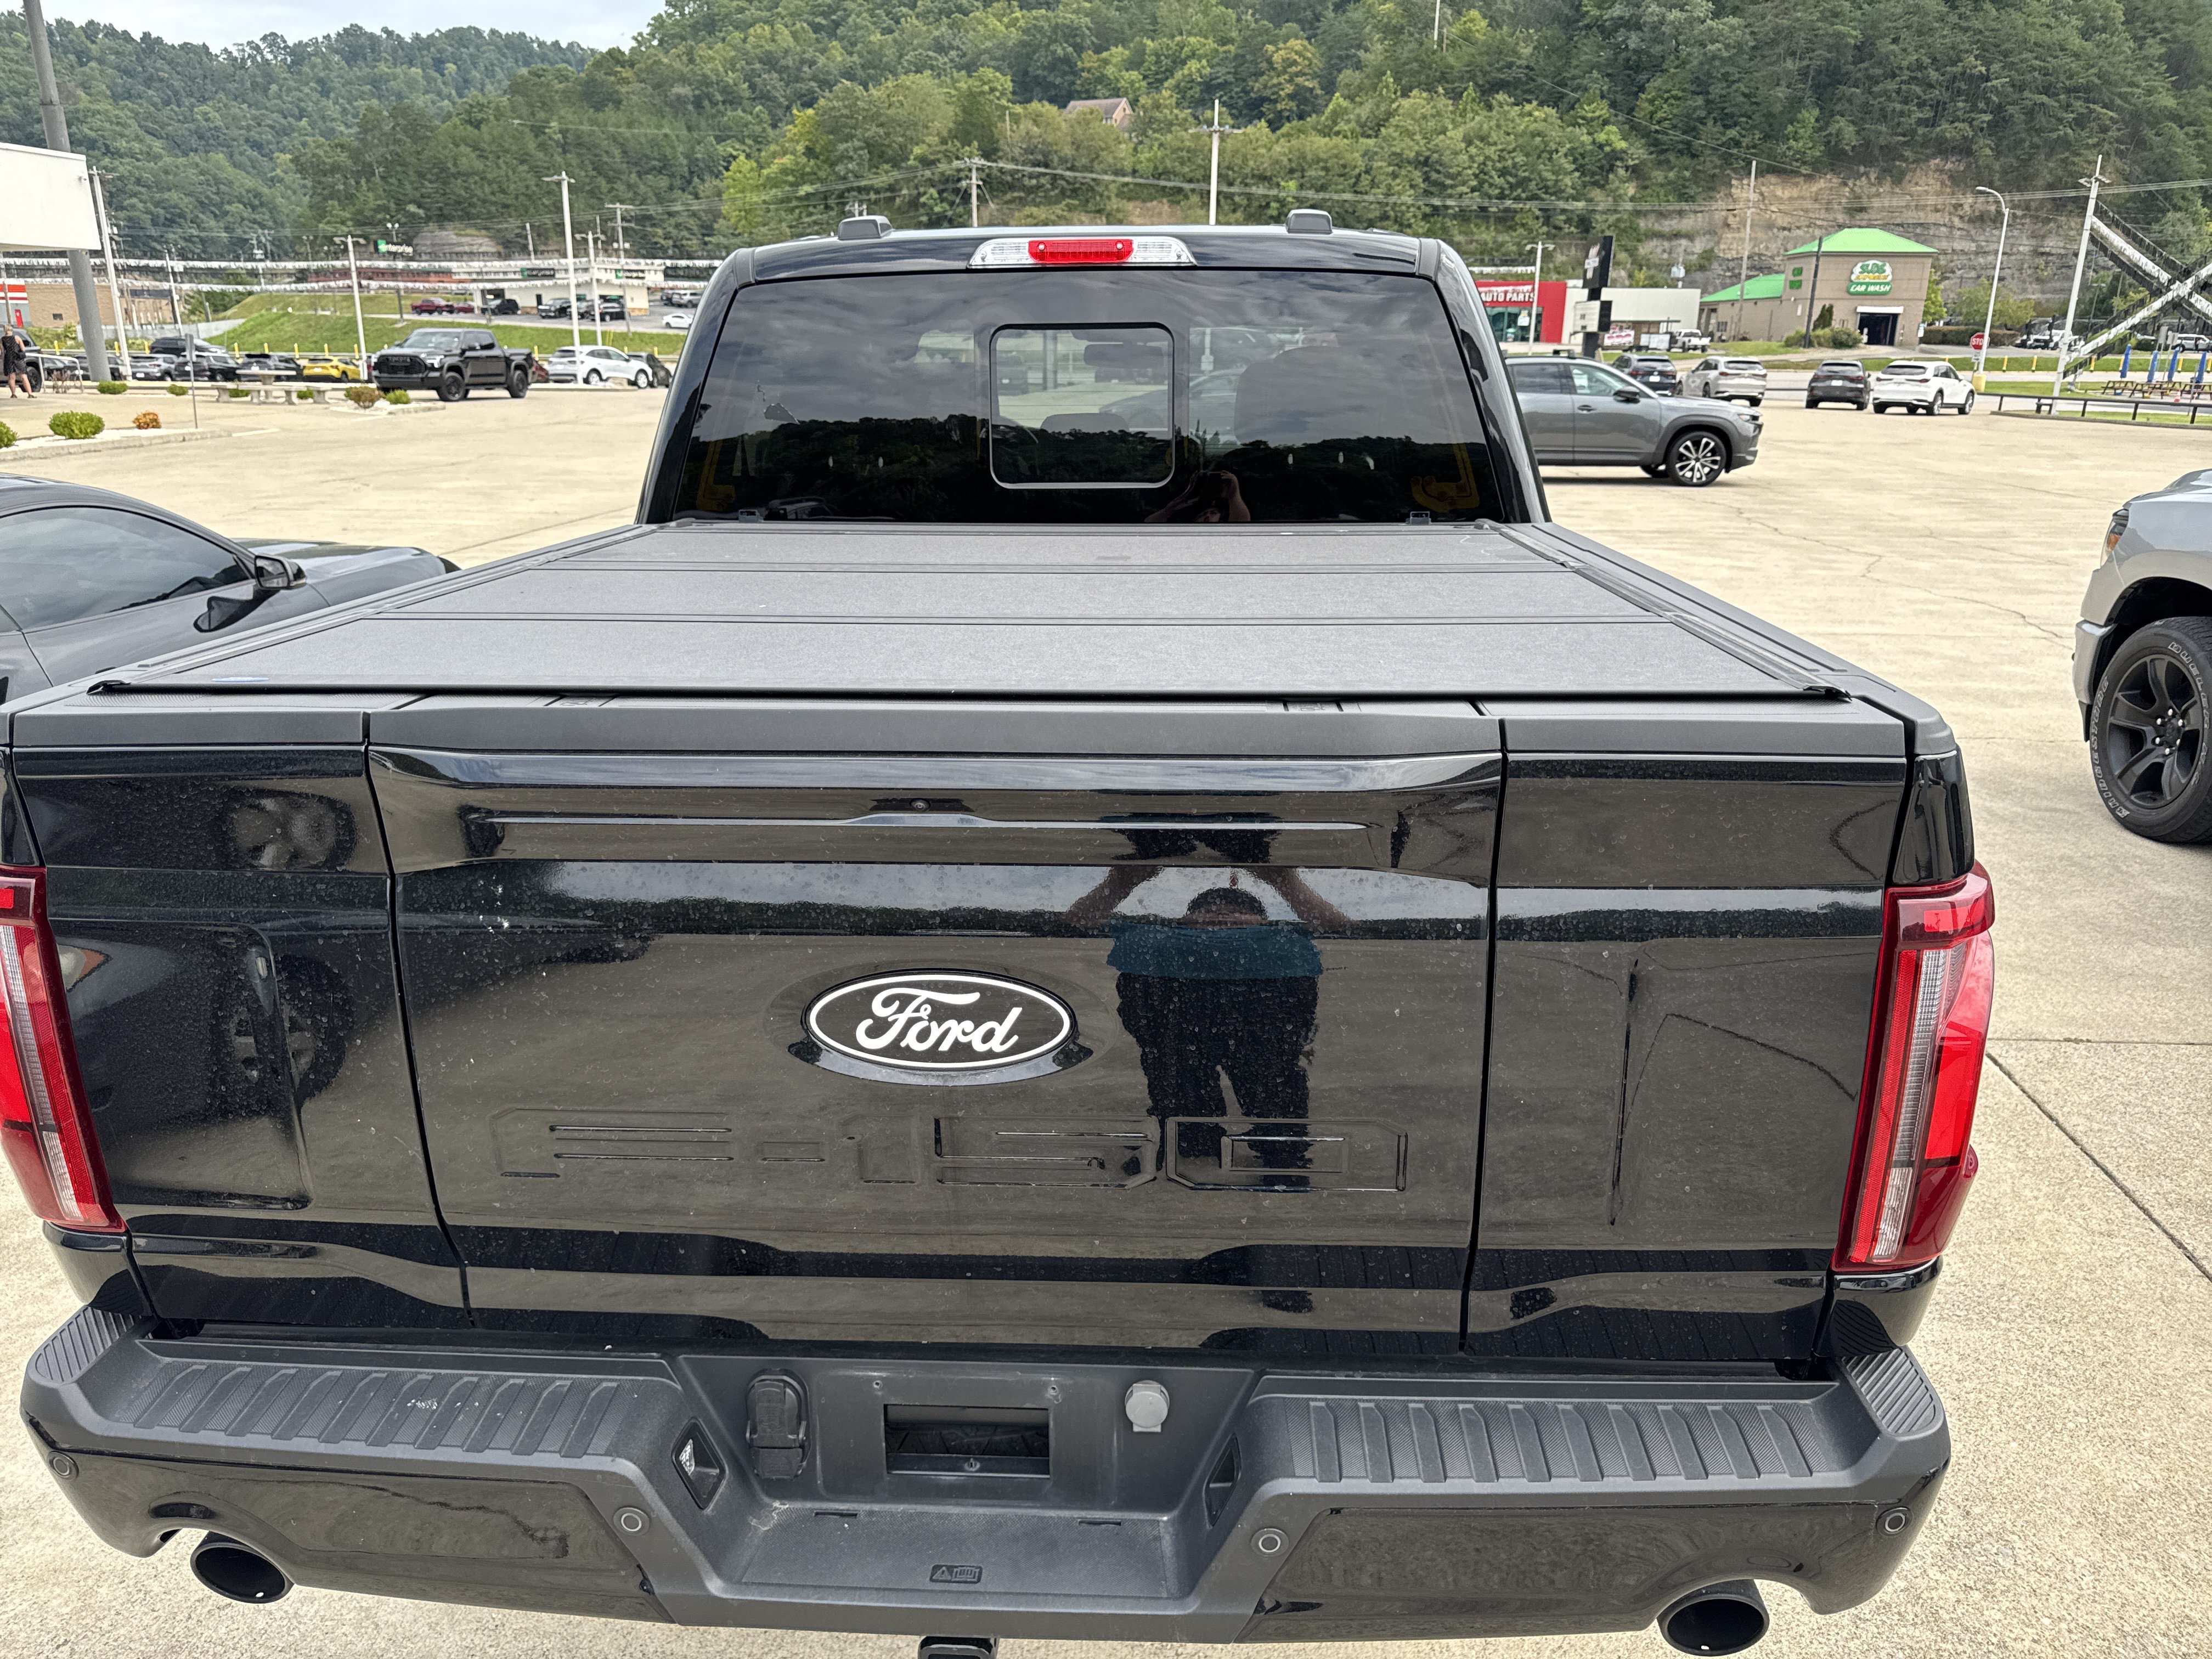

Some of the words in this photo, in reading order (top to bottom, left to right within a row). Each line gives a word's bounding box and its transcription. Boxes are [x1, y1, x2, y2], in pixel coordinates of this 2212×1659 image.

[1480, 292, 1504, 302] AUTO
[1506, 292, 1534, 302] PARTS
[1972, 337, 1984, 346] STO
[2091, 675, 2130, 818] BRIDGESTONE
[856, 988, 1023, 1052] Ford
